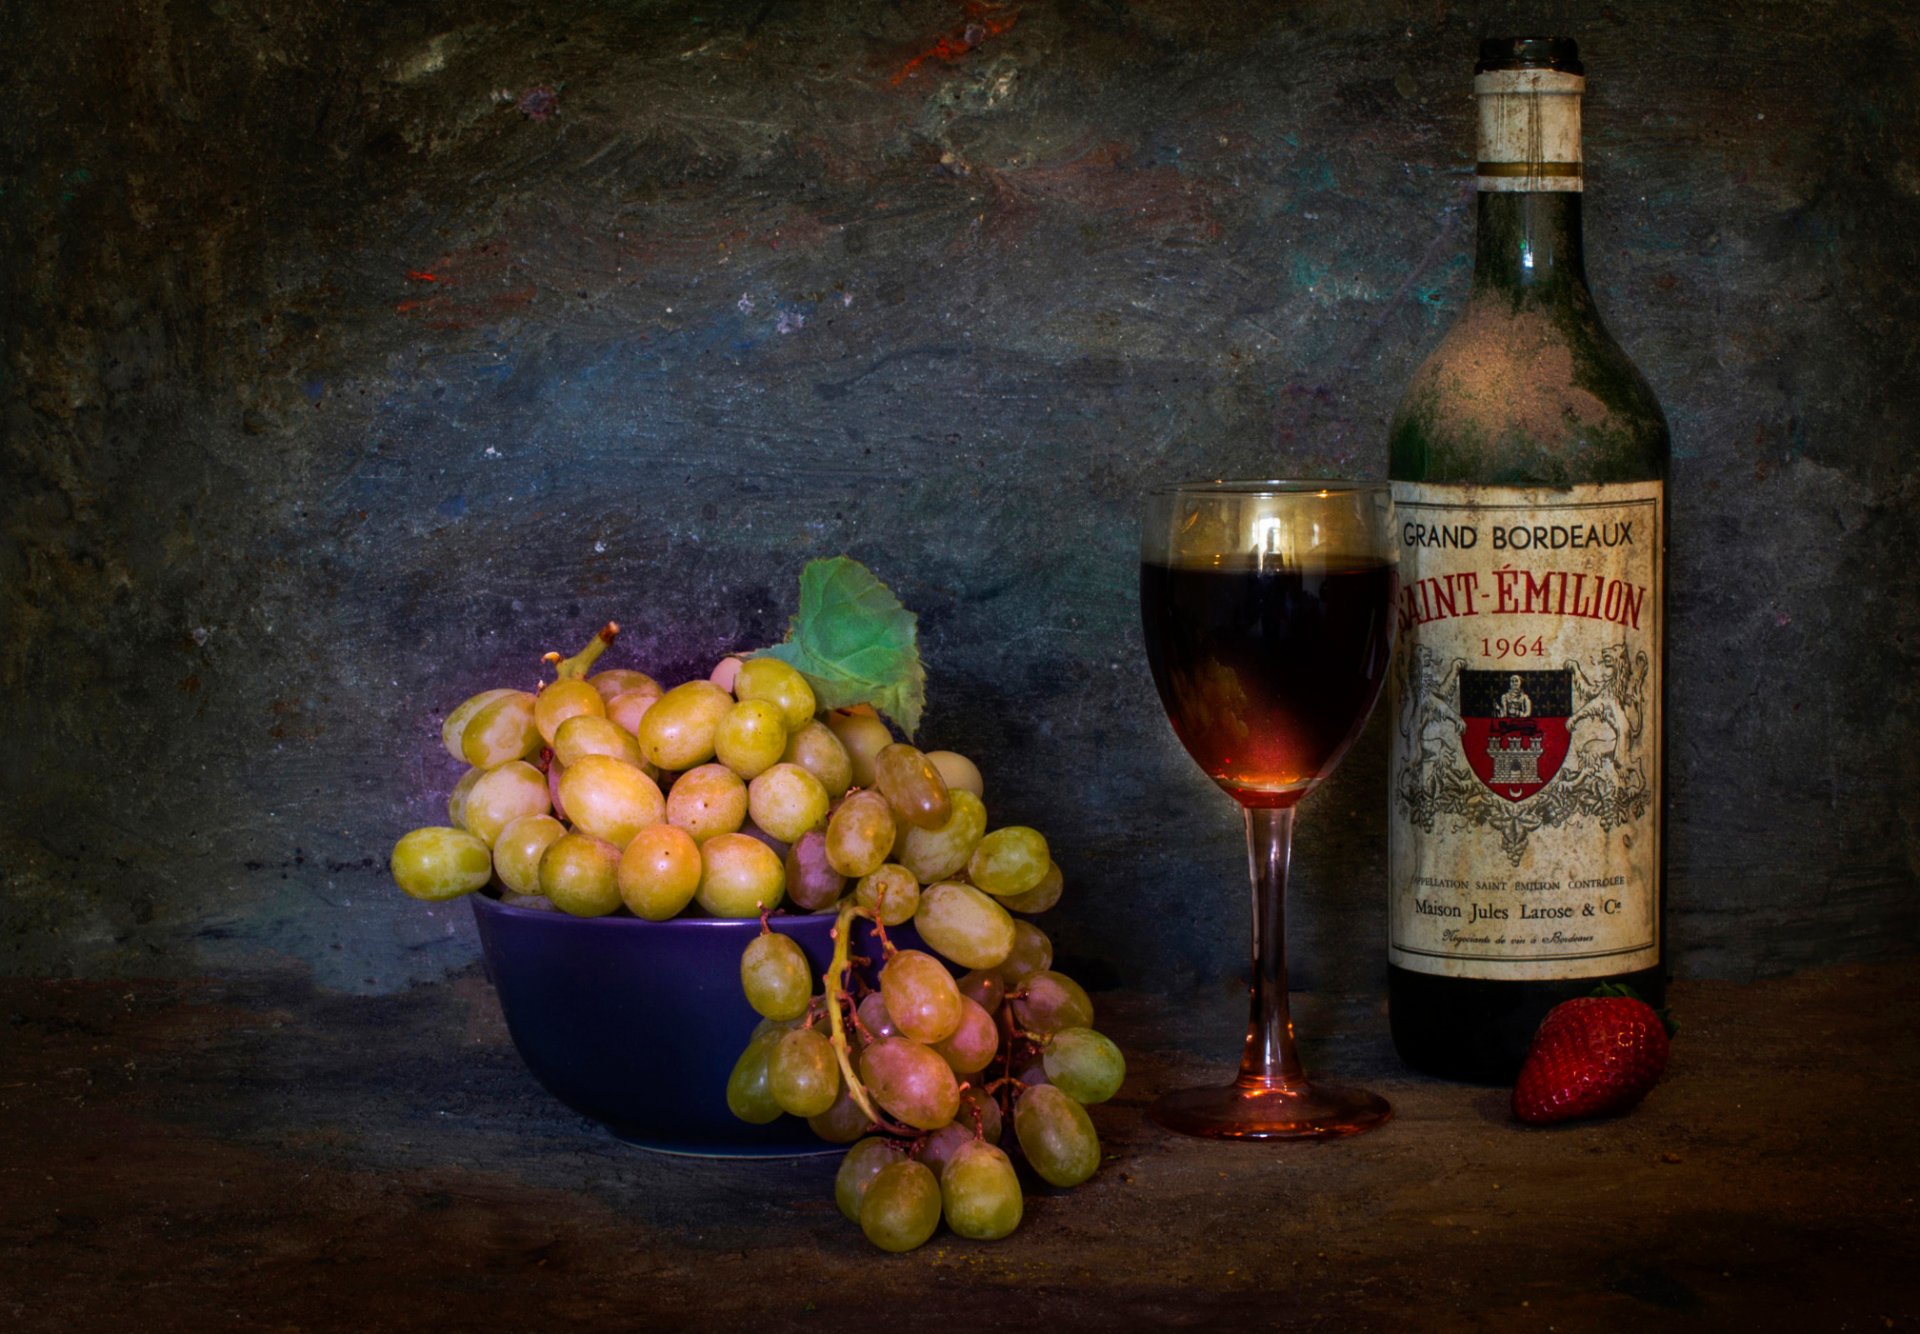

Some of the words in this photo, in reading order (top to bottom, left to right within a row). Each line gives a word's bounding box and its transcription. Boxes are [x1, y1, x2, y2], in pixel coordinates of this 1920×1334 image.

[1403, 522, 1477, 549] GRAND
[1493, 522, 1634, 550] BORDEAUX
[1481, 635, 1545, 660] 1964
[1476, 880, 1507, 891] SAINT
[1415, 898, 1462, 917] Maison
[1469, 902, 1509, 924] Jules
[1520, 903, 1573, 919] Larose
[1582, 903, 1595, 916] &
[1495, 935, 1506, 944] de
[1542, 930, 1595, 945] Bordeaux
